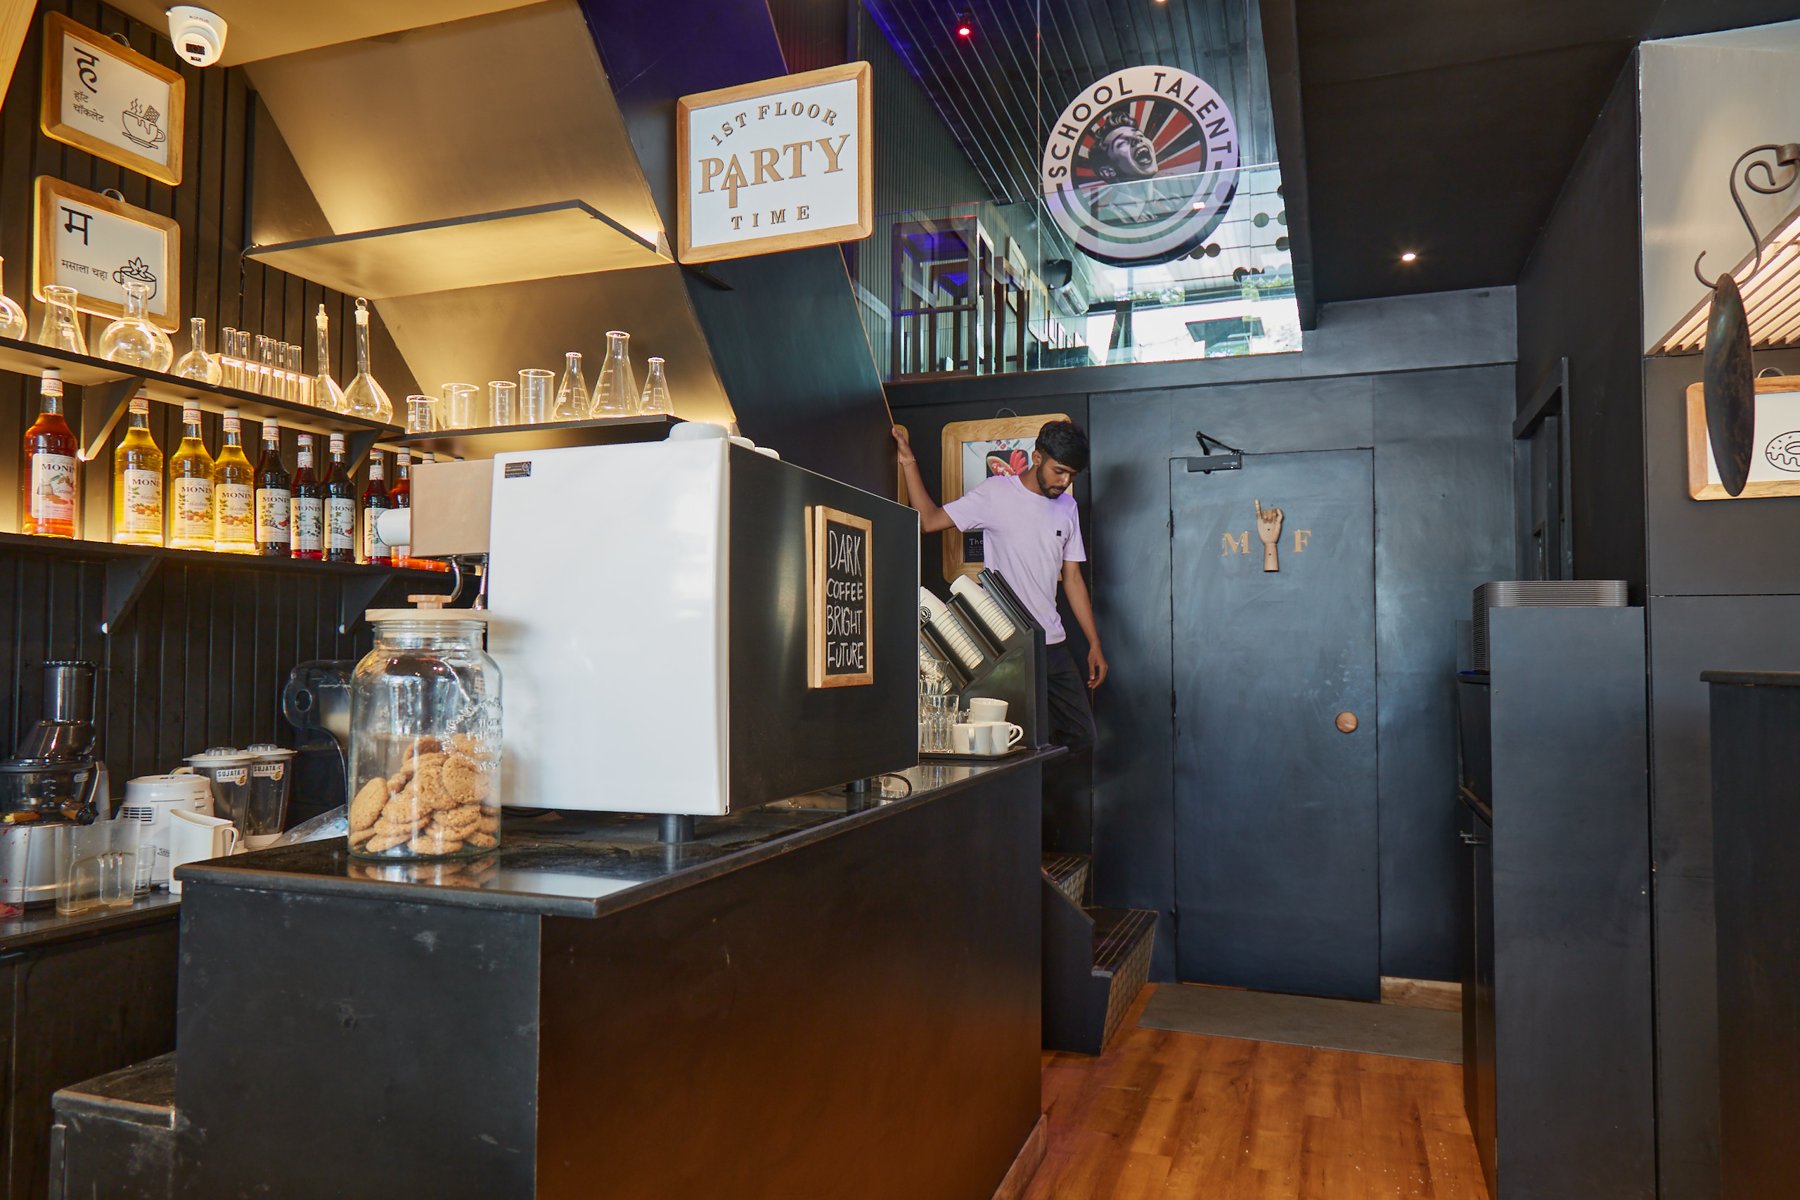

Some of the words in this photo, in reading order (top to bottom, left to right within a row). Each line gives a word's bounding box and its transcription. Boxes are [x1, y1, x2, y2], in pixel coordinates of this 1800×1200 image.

[73, 46, 101, 94] ह
[711, 112, 748, 147] 1ST
[758, 101, 838, 127] FLOOR
[1048, 77, 1133, 179] SCHOOL
[1154, 72, 1232, 155] TALENT
[698, 134, 851, 205] PARTY
[60, 205, 94, 247] म
[731, 205, 810, 231] TIME
[829, 530, 862, 577] DARK
[1221, 530, 1251, 557] M
[1294, 528, 1313, 553] F
[826, 578, 864, 602] COFFEE
[826, 604, 864, 637] BRIGHT
[827, 641, 864, 669] FUTURE
